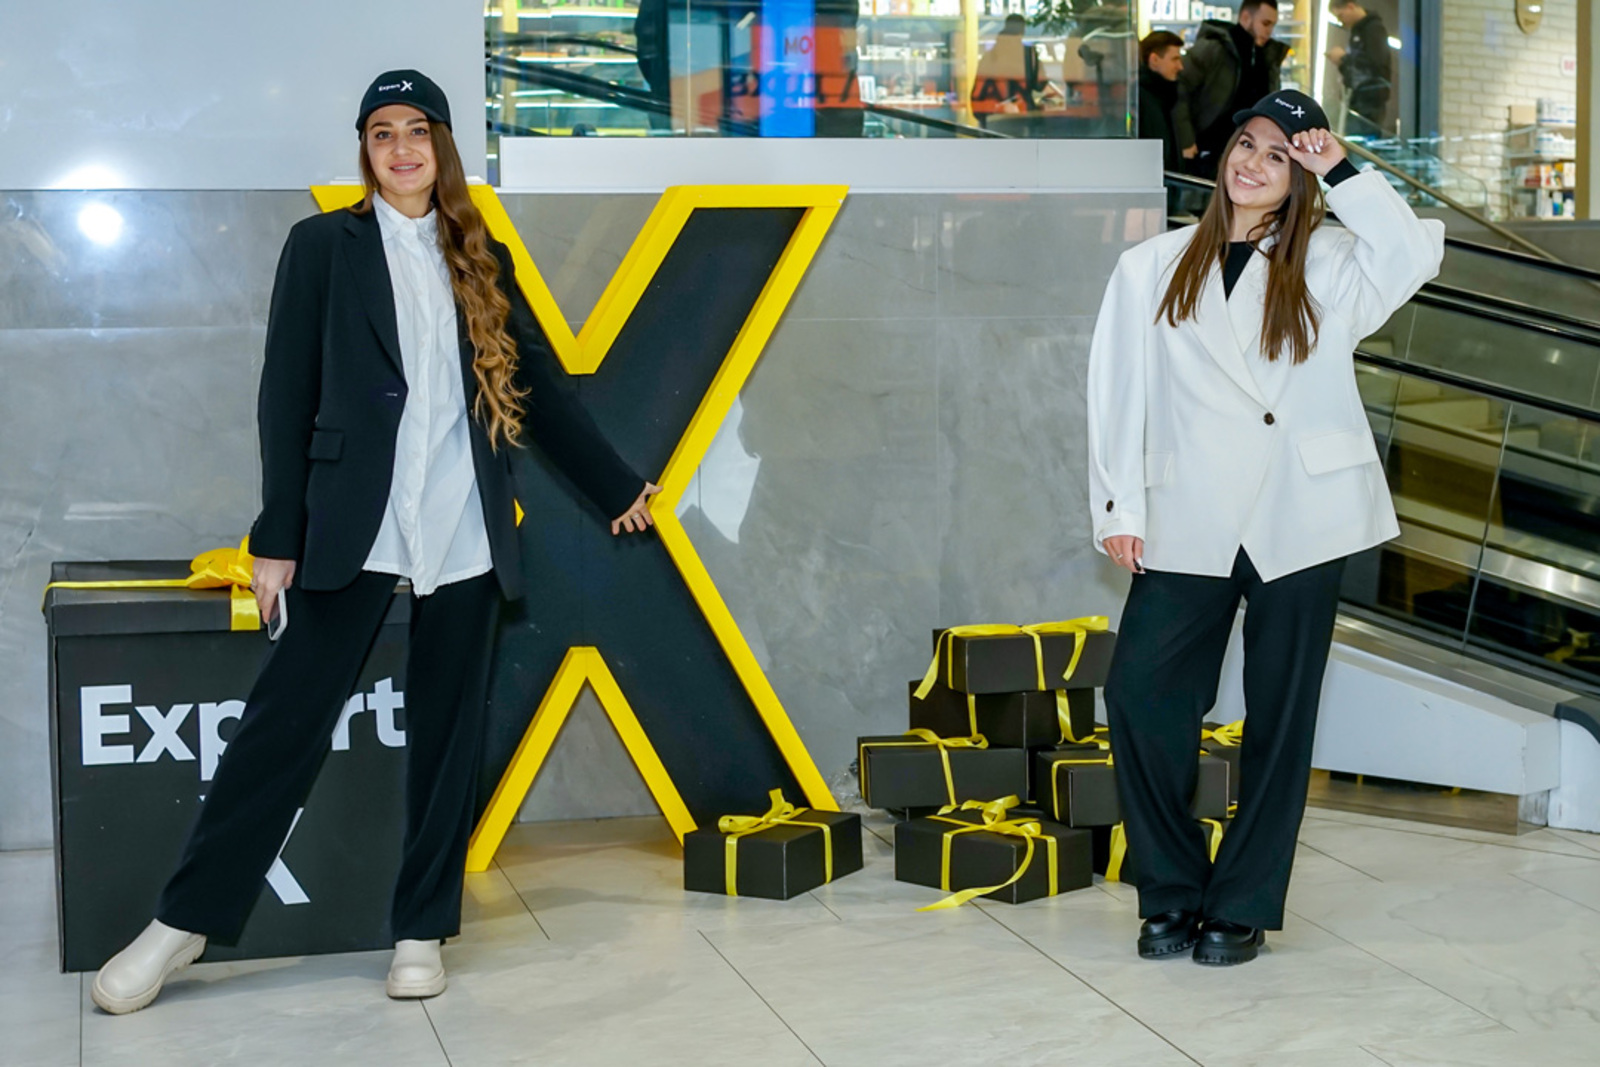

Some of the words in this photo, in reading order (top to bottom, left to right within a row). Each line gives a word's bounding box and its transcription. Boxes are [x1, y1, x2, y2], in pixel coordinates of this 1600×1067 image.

[379, 84, 400, 92] Expert
[400, 80, 413, 92] X
[1291, 105, 1305, 119] X
[80, 676, 407, 782] Exprt
